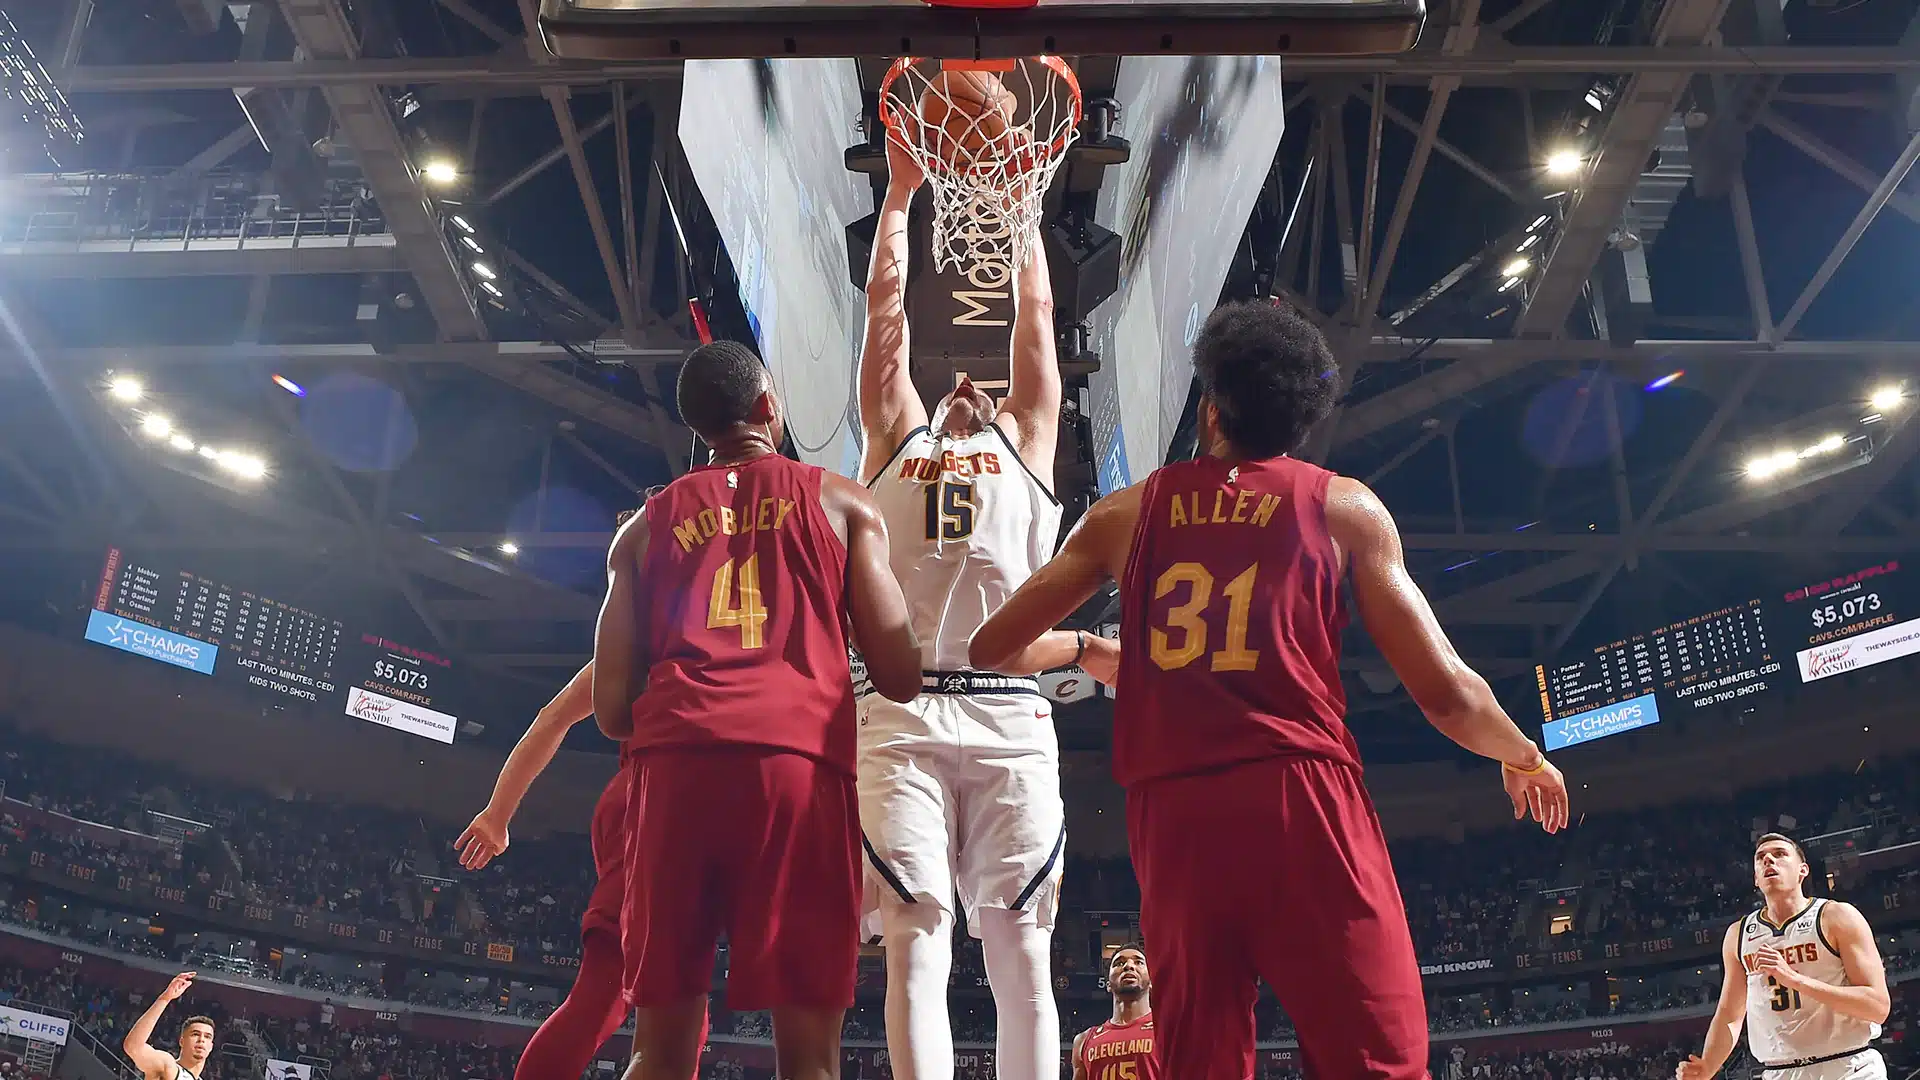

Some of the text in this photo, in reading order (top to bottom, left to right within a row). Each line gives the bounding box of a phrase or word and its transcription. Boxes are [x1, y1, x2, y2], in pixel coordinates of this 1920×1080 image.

[925, 481, 976, 542] 15
[1170, 489, 1282, 528] ALLEN
[673, 497, 795, 553] MOBLEY
[707, 552, 768, 649] 4
[1811, 593, 1881, 628] $5,073
[1151, 562, 1260, 672] 31
[1809, 613, 1895, 644] CAVS.COM/RAFFLE
[133, 630, 199, 660] CHAMPS
[237, 657, 258, 670] LAST
[259, 663, 278, 675] TWO
[279, 668, 315, 687] MINUTES.
[316, 677, 335, 692] CEDI
[248, 675, 318, 702] KIDS TWO SHOTS.
[373, 660, 428, 689] $5,073
[1676, 662, 1781, 698] LAST TWO MINUTES. CEDI
[1694, 682, 1769, 708] KIDS TWO SHOTS.
[400, 713, 450, 732] THEWAYSIDE.ORG
[1581, 704, 1642, 731] CHAMPS
[30, 851, 45, 867] DE
[118, 876, 133, 892] DE
[209, 896, 223, 911] DE
[294, 914, 308, 929] DE
[379, 930, 393, 944] DE
[464, 942, 478, 955] DE
[1516, 954, 1531, 968] DE
[1605, 943, 1620, 958] DE
[1695, 929, 1710, 944] DE
[1884, 893, 1900, 910] DE
[1797, 921, 1813, 929] WU
[542, 955, 580, 967] $5,073
[1444, 959, 1494, 973] KNOW.
[19, 1019, 65, 1037] CLIFFS
[376, 1012, 397, 1021] M125
[1591, 1029, 1613, 1038] M103
[1087, 1038, 1153, 1063] CLEVELAND
[1271, 1052, 1292, 1060] M102
